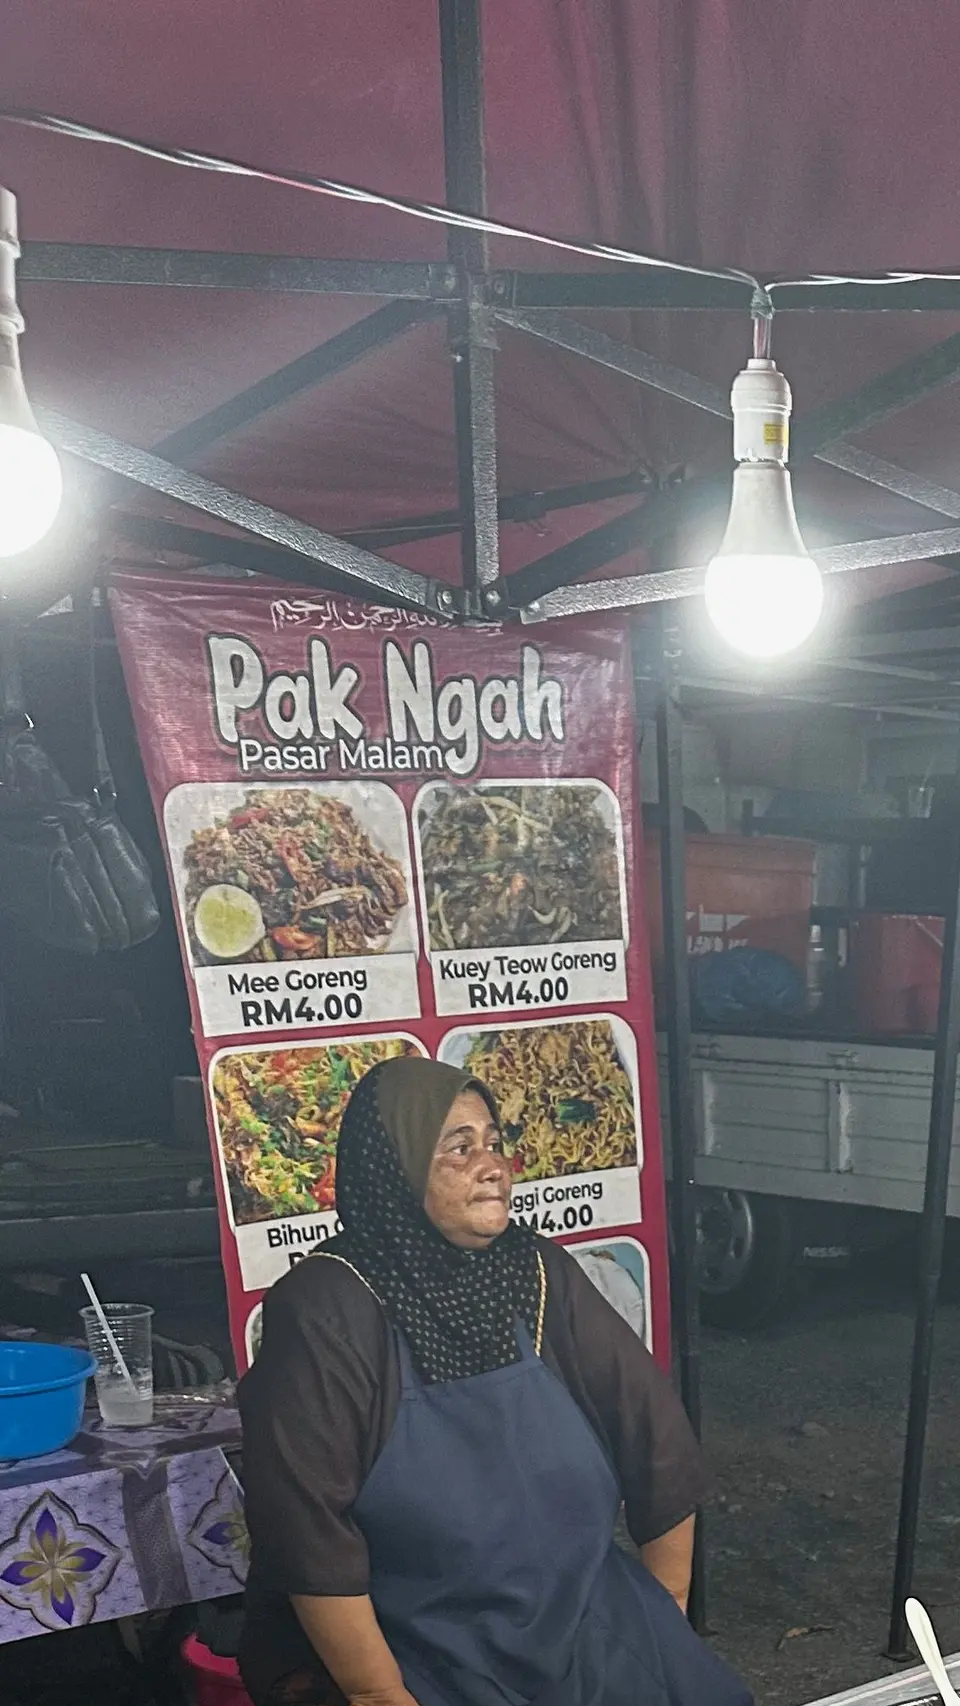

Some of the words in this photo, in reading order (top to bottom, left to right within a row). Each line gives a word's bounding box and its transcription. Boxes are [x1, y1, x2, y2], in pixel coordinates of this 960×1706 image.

[206, 635, 364, 744] Pak
[384, 639, 565, 775] Ngah
[239, 738, 330, 772] Pasar
[339, 738, 444, 770] Malam
[228, 971, 280, 995] Mee
[285, 966, 368, 993] Goreng
[439, 960, 493, 981] Kuey
[495, 955, 546, 975] Teow
[550, 950, 617, 974] Goreng
[467, 976, 569, 1009] RM4.00
[241, 992, 363, 1027] RM4.00
[510, 1187, 540, 1213] ggi
[543, 1182, 603, 1204] Goreng
[510, 1203, 594, 1233] M4.00
[266, 1223, 329, 1248] Bihun
